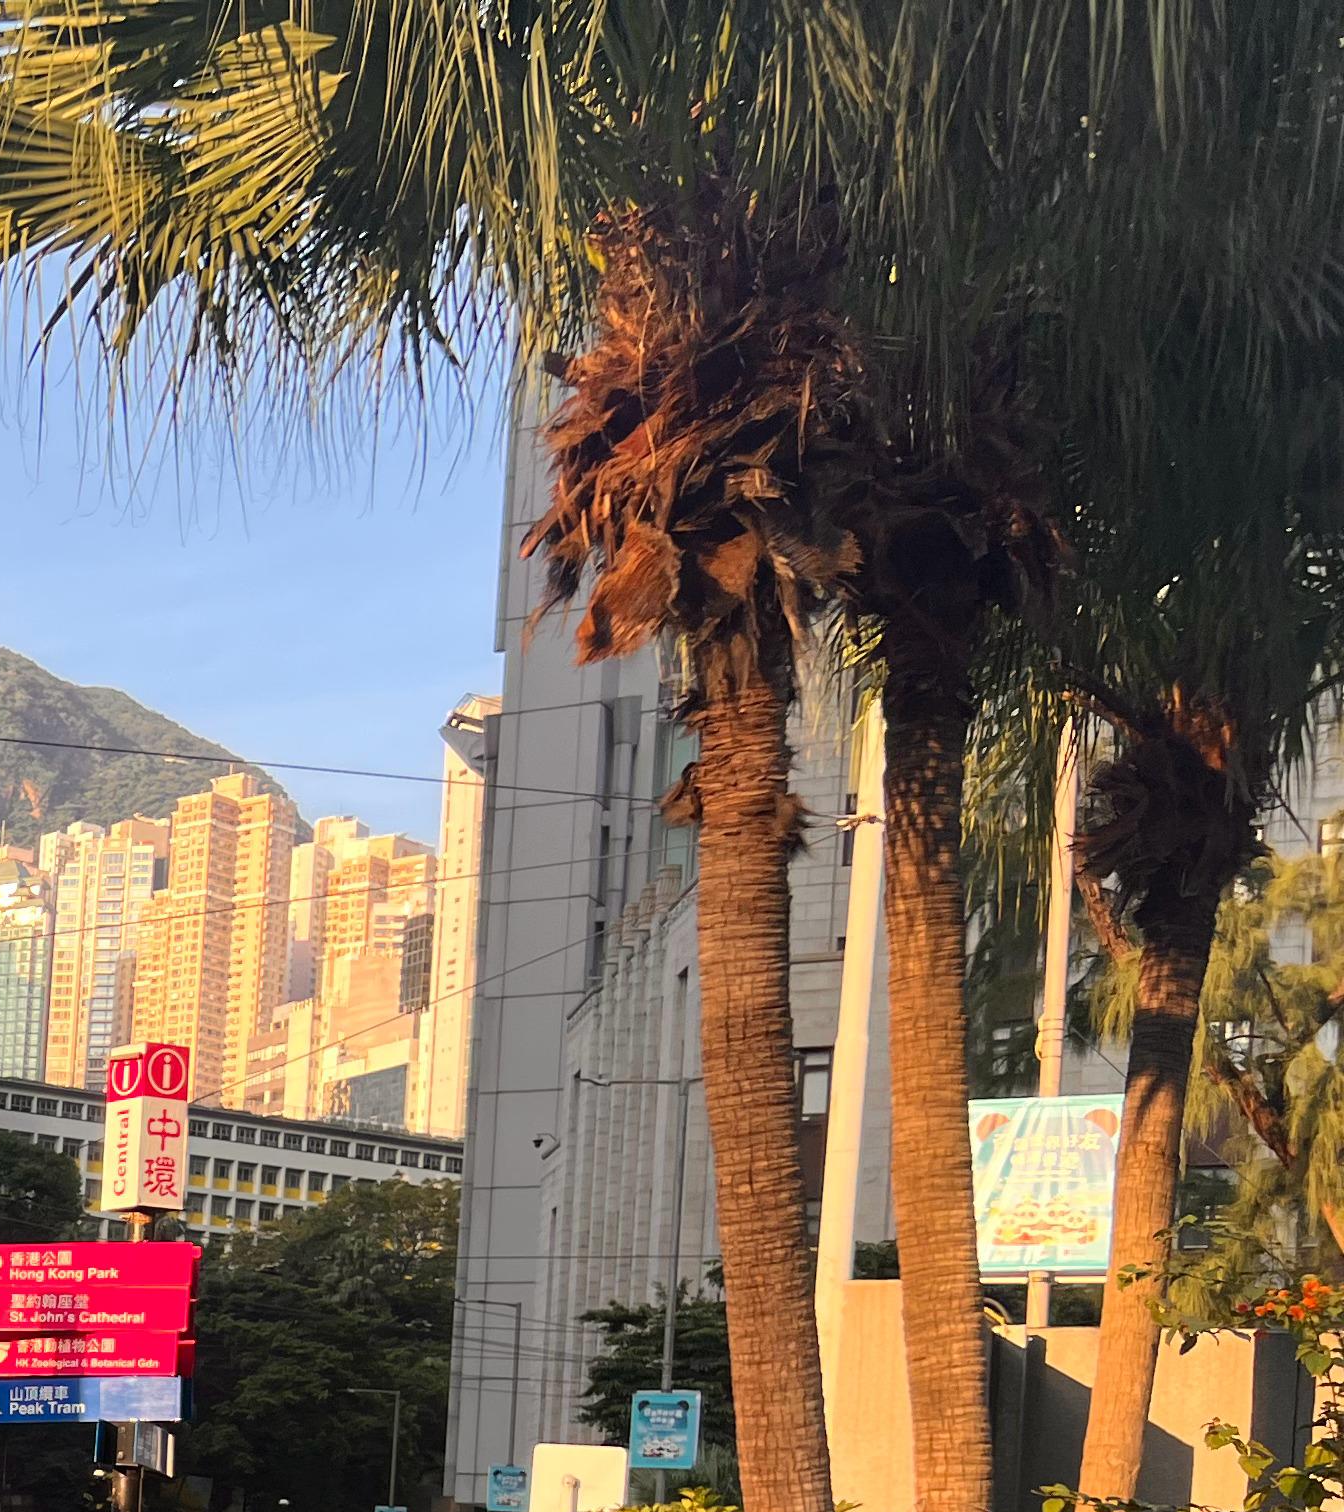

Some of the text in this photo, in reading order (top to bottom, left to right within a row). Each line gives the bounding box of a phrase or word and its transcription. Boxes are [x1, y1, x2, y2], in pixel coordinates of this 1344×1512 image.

[113, 1109, 130, 1197] Central
[143, 1109, 181, 1197] 中環
[10, 1250, 73, 1267] 香港公園
[9, 1267, 120, 1282] Hong Kong Park
[9, 1311, 146, 1324] St. John's Cathedral
[15, 1359, 29, 1368] HK
[31, 1358, 79, 1369] Zoological
[90, 1358, 135, 1368] Botanical
[137, 1358, 160, 1368] Gdn
[9, 1401, 86, 1415] Peak Tram
